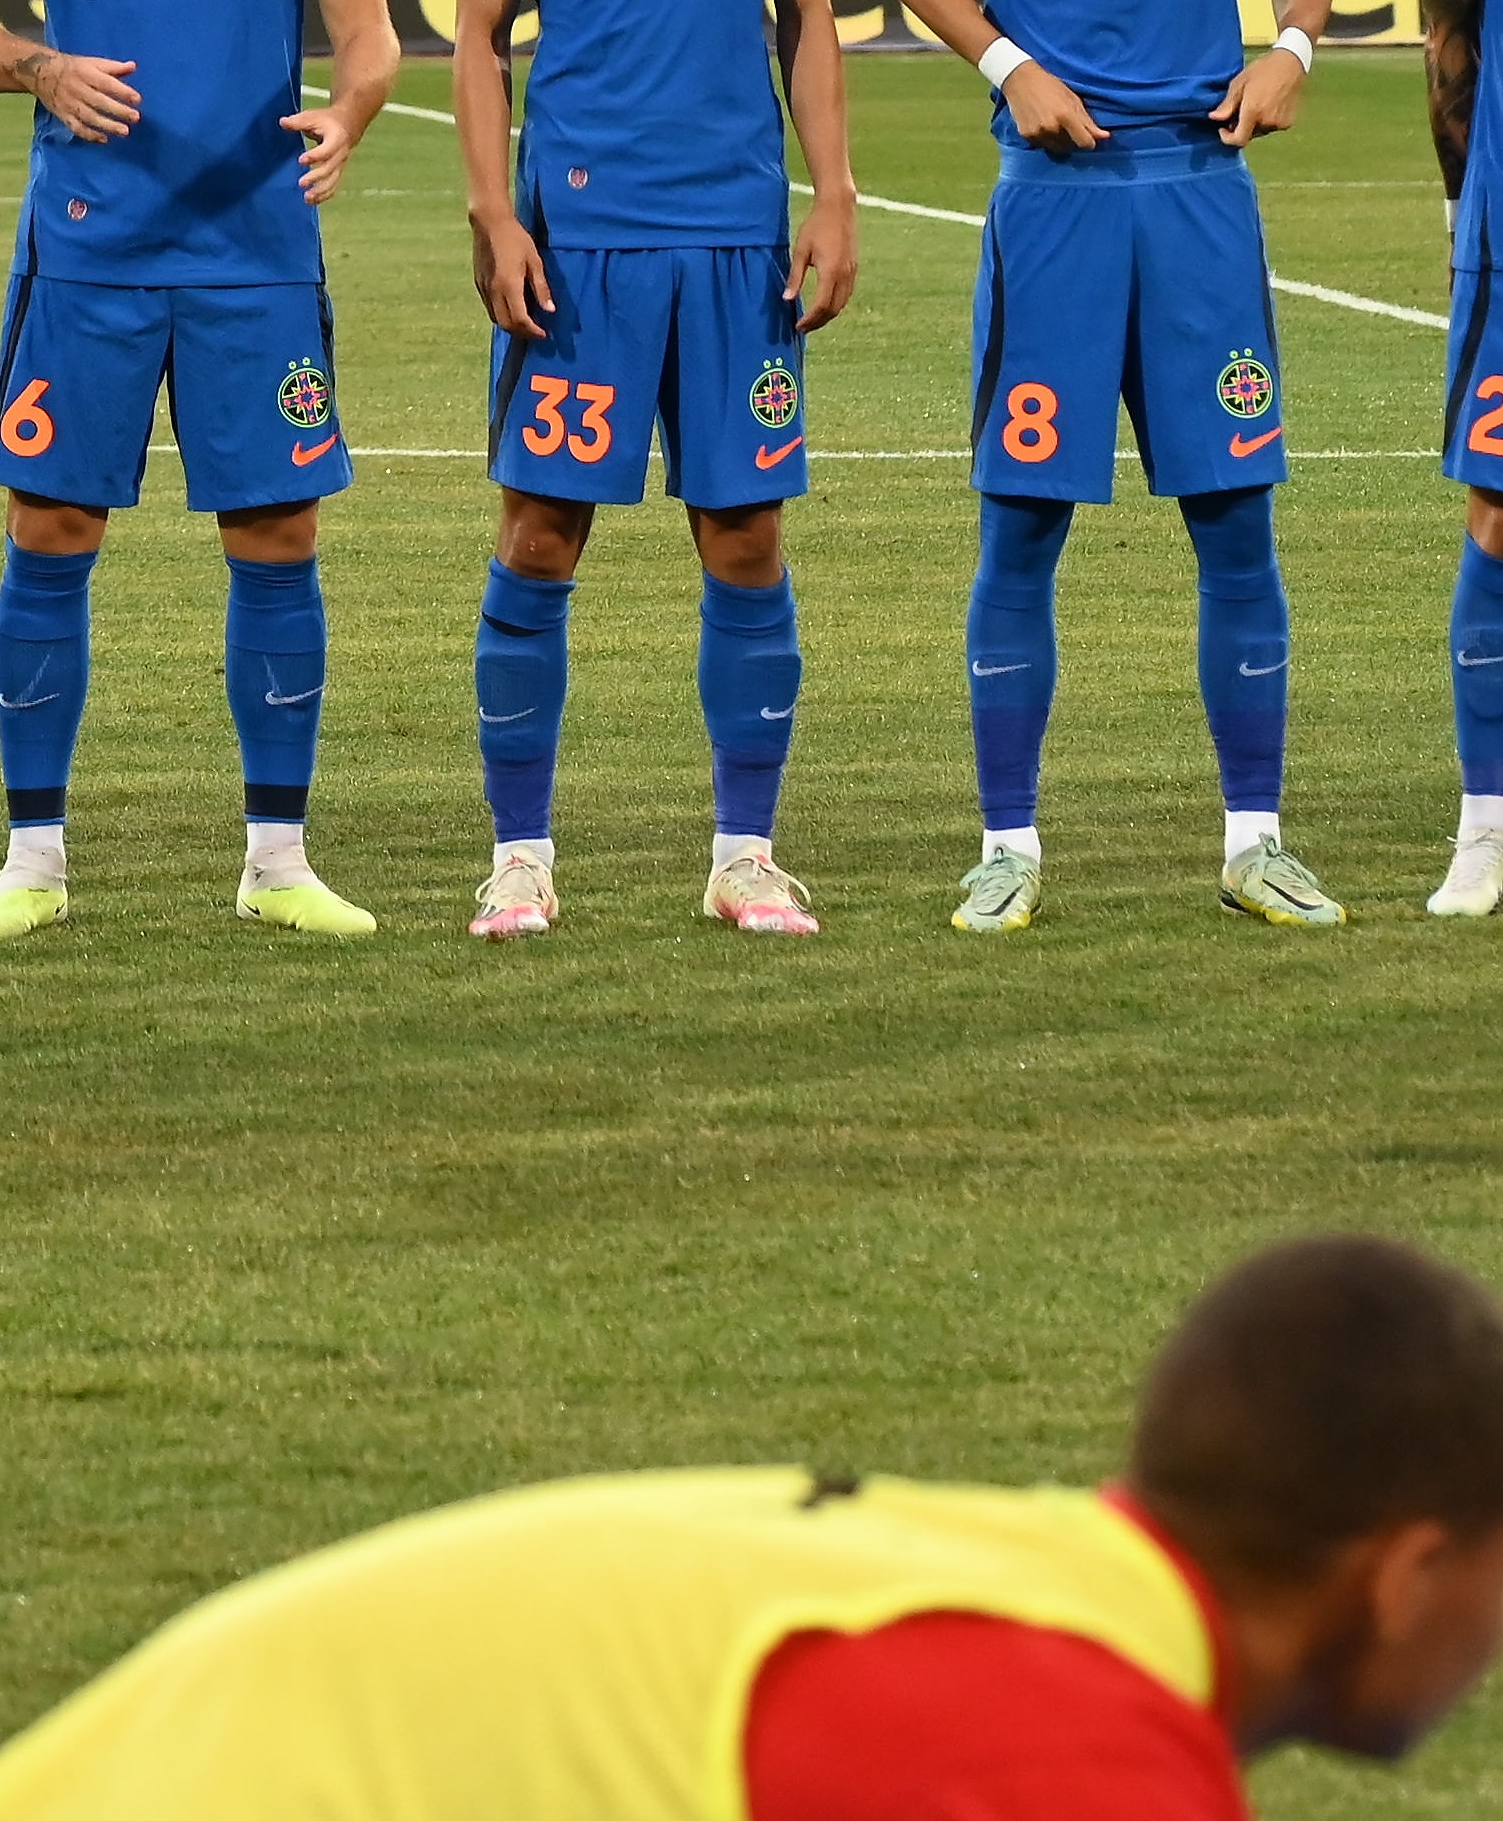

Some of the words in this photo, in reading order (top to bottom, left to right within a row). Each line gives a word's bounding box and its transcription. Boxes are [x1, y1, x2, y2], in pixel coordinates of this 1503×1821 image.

[0, 378, 54, 457] 6
[522, 374, 616, 464] 33
[1002, 382, 1059, 463] 8
